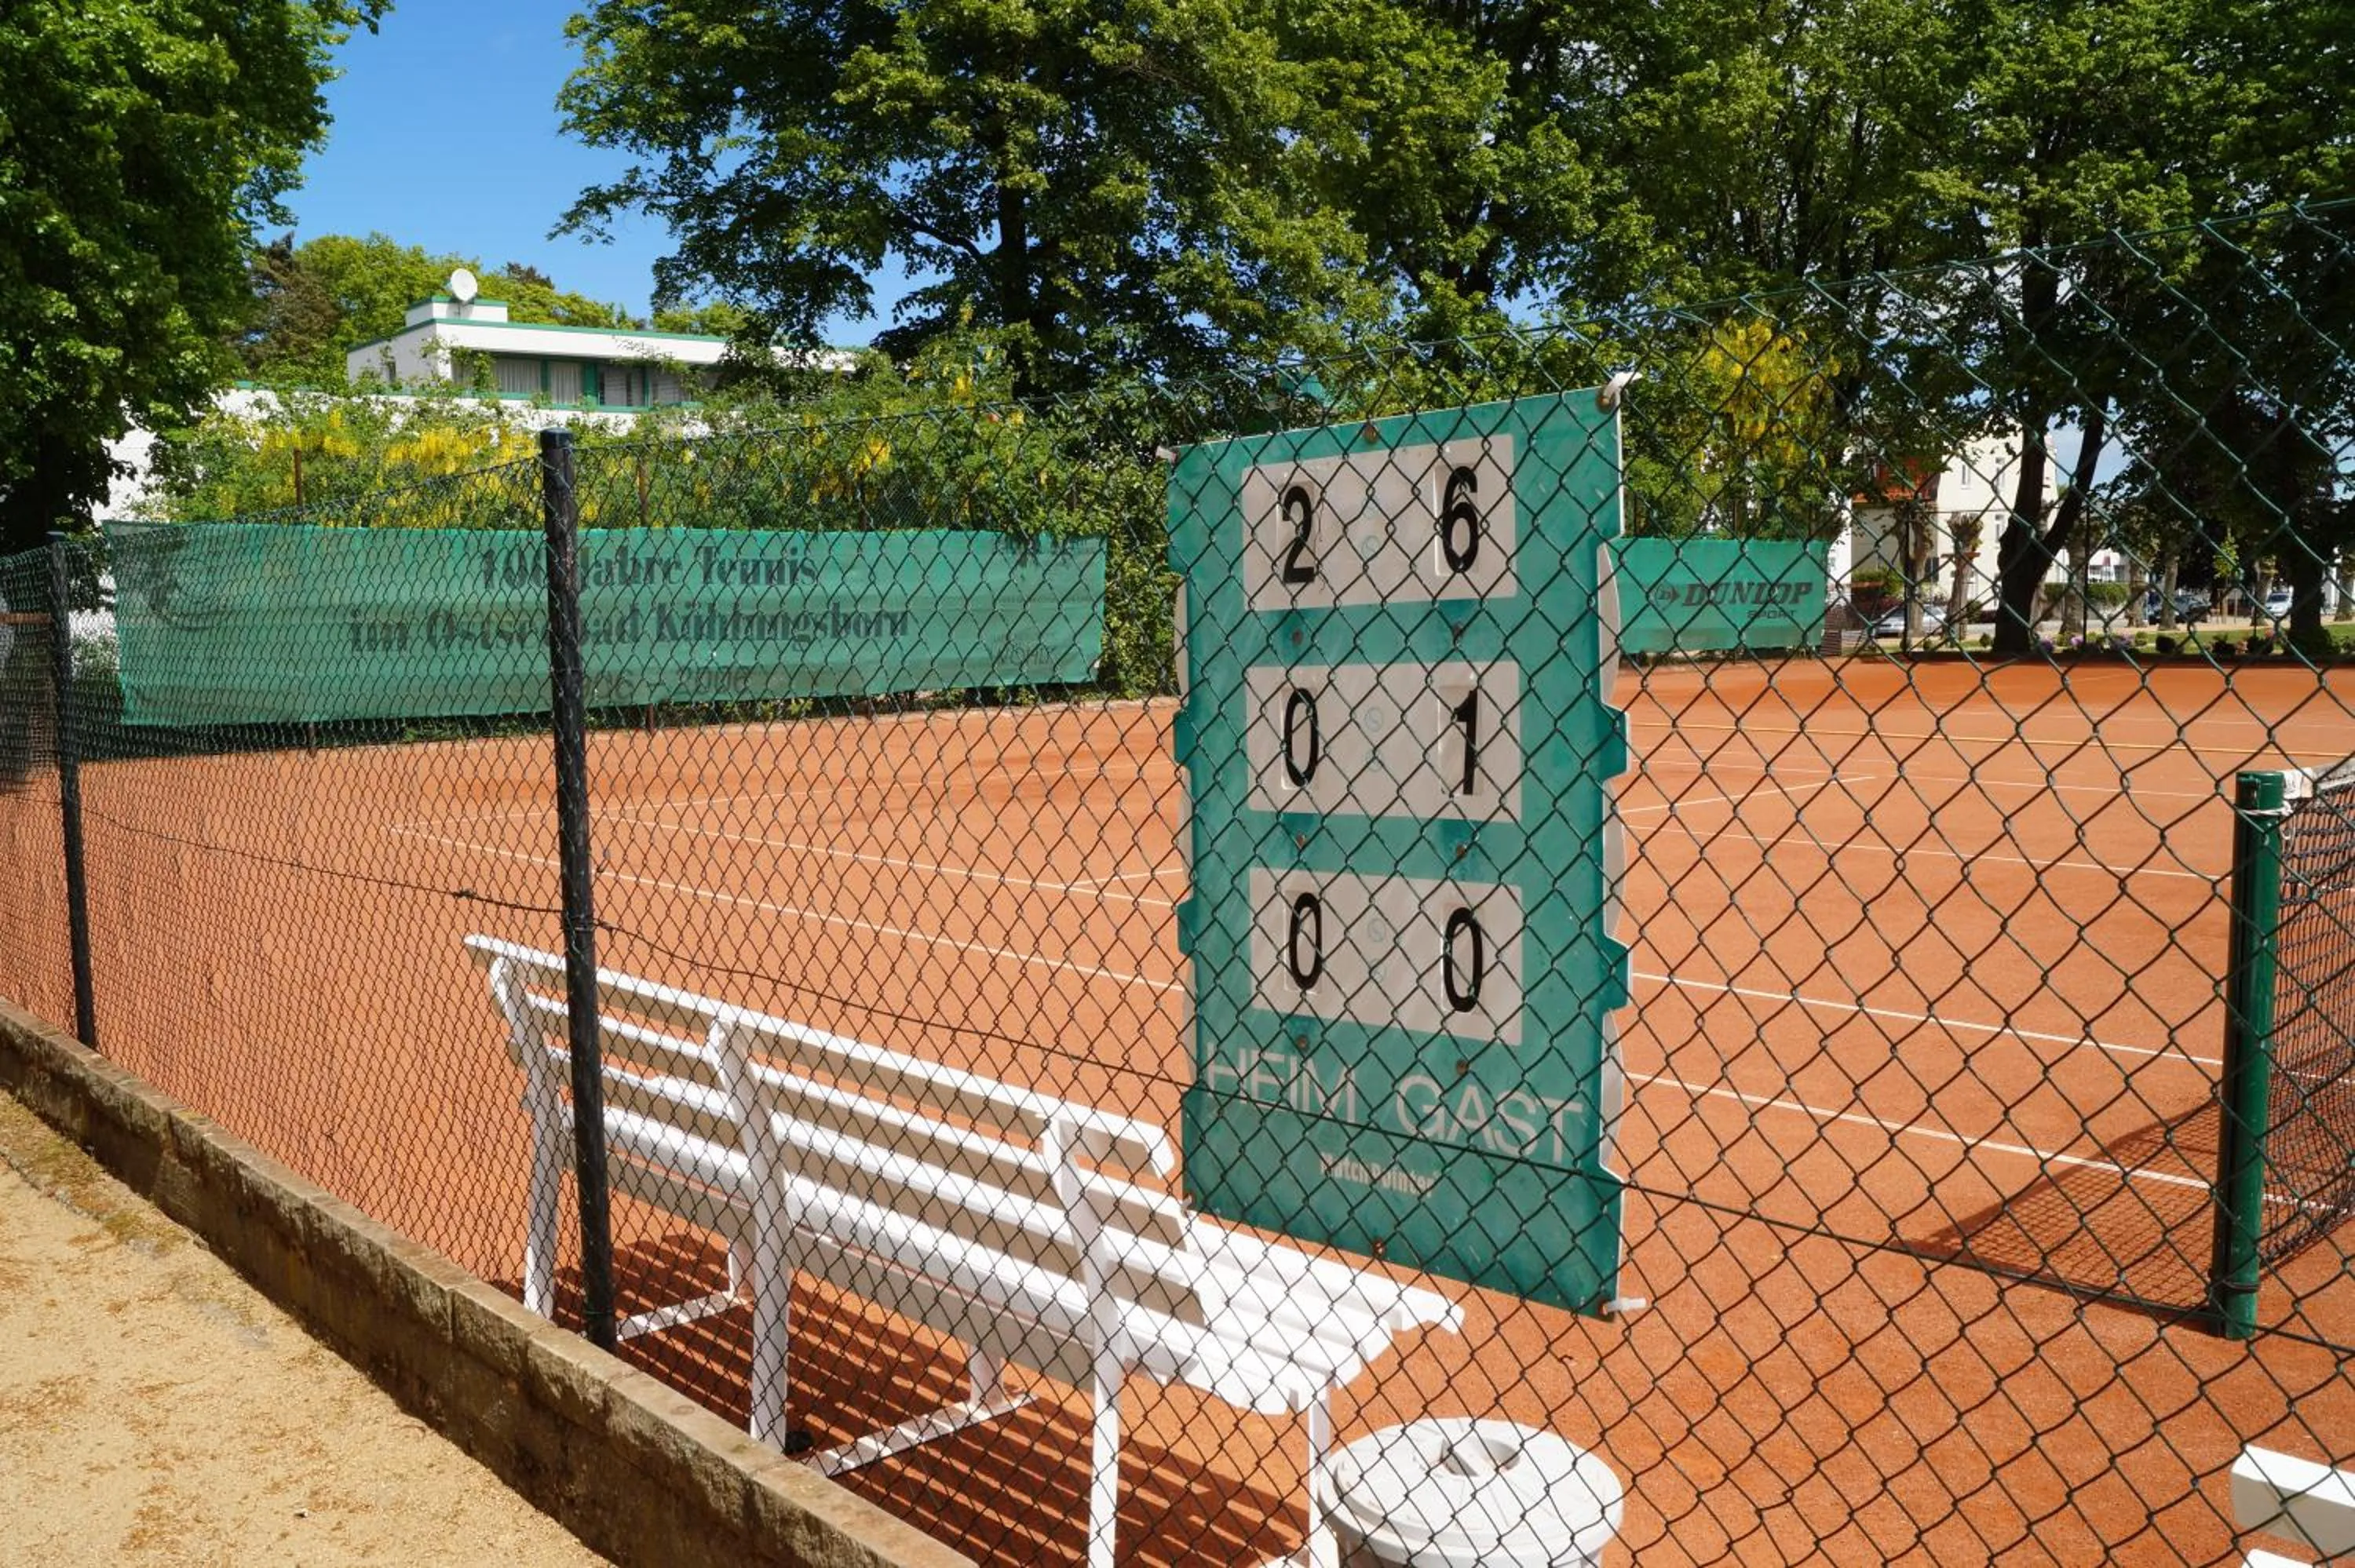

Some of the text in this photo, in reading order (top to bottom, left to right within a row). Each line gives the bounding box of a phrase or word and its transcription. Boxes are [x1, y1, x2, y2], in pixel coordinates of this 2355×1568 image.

[1282, 465, 1479, 584] 2 6
[696, 545, 817, 585] Tennis
[1681, 581, 1813, 607] DUNLOP
[351, 607, 409, 652] im
[655, 600, 910, 652] Kühlungsborn
[1747, 609, 1797, 619] SPORT
[1283, 687, 1479, 796] 0 1
[1289, 892, 1484, 1013] 0 0
[1207, 1041, 1584, 1163] HEIM GAST
